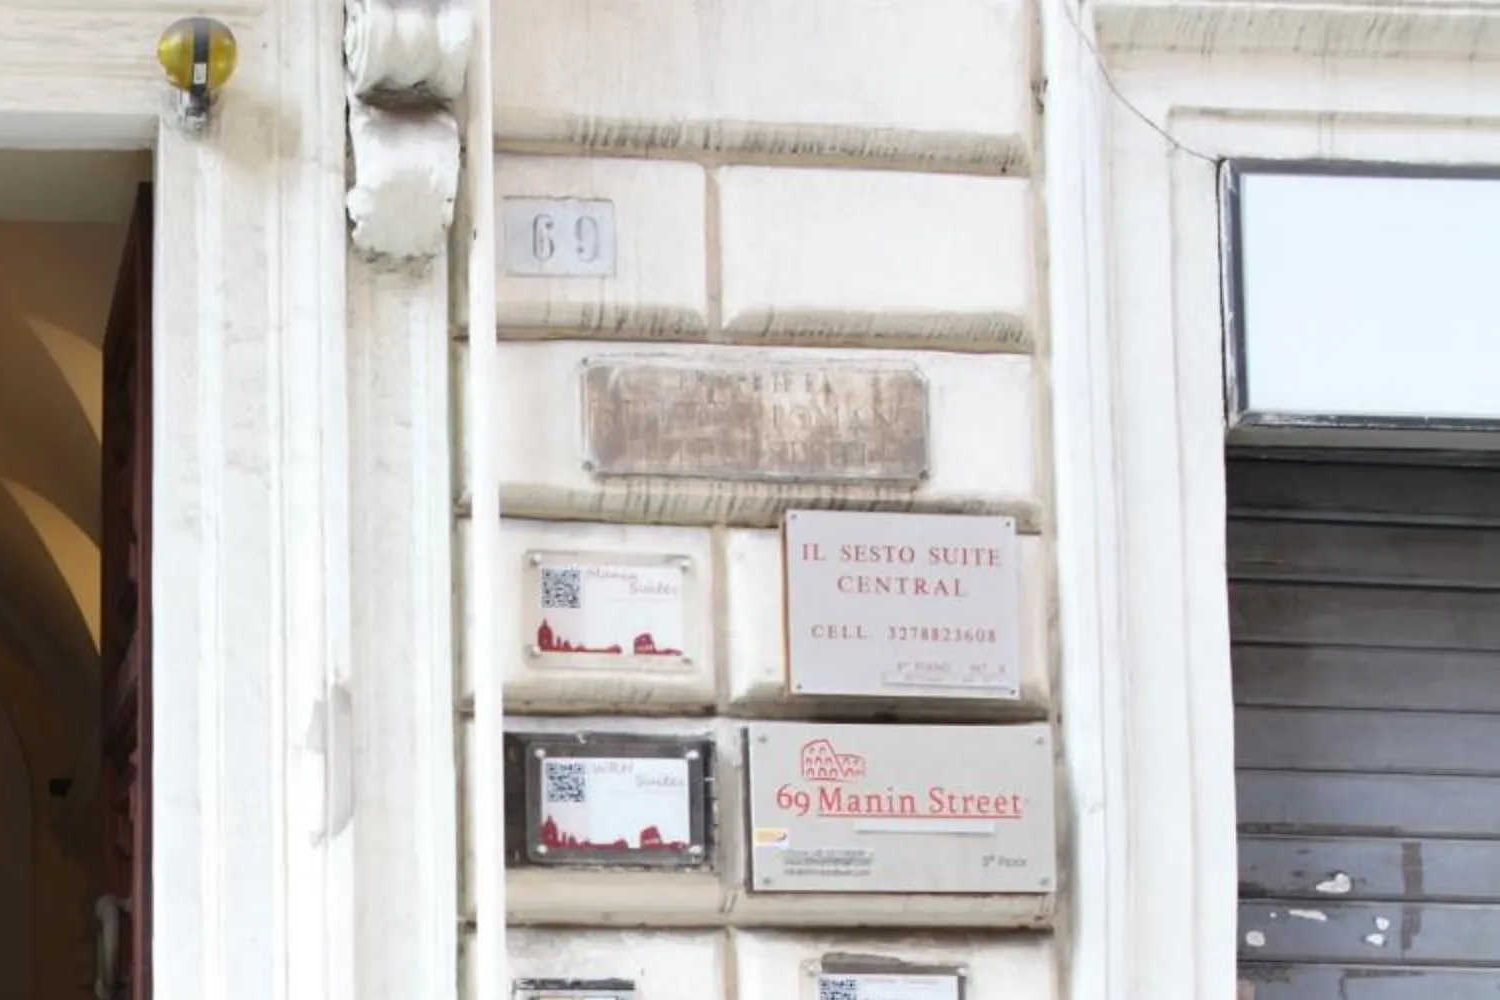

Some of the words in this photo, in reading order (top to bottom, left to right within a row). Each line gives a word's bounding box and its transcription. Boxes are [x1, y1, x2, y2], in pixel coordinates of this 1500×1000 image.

[532, 213, 601, 264] 69
[802, 543, 827, 562] IL
[840, 544, 916, 565] SESTO
[928, 546, 1002, 568] SUITE
[836, 575, 968, 598] CENTRAL
[775, 785, 811, 817] 69
[818, 786, 917, 813] Manin
[928, 787, 1023, 815] Street
